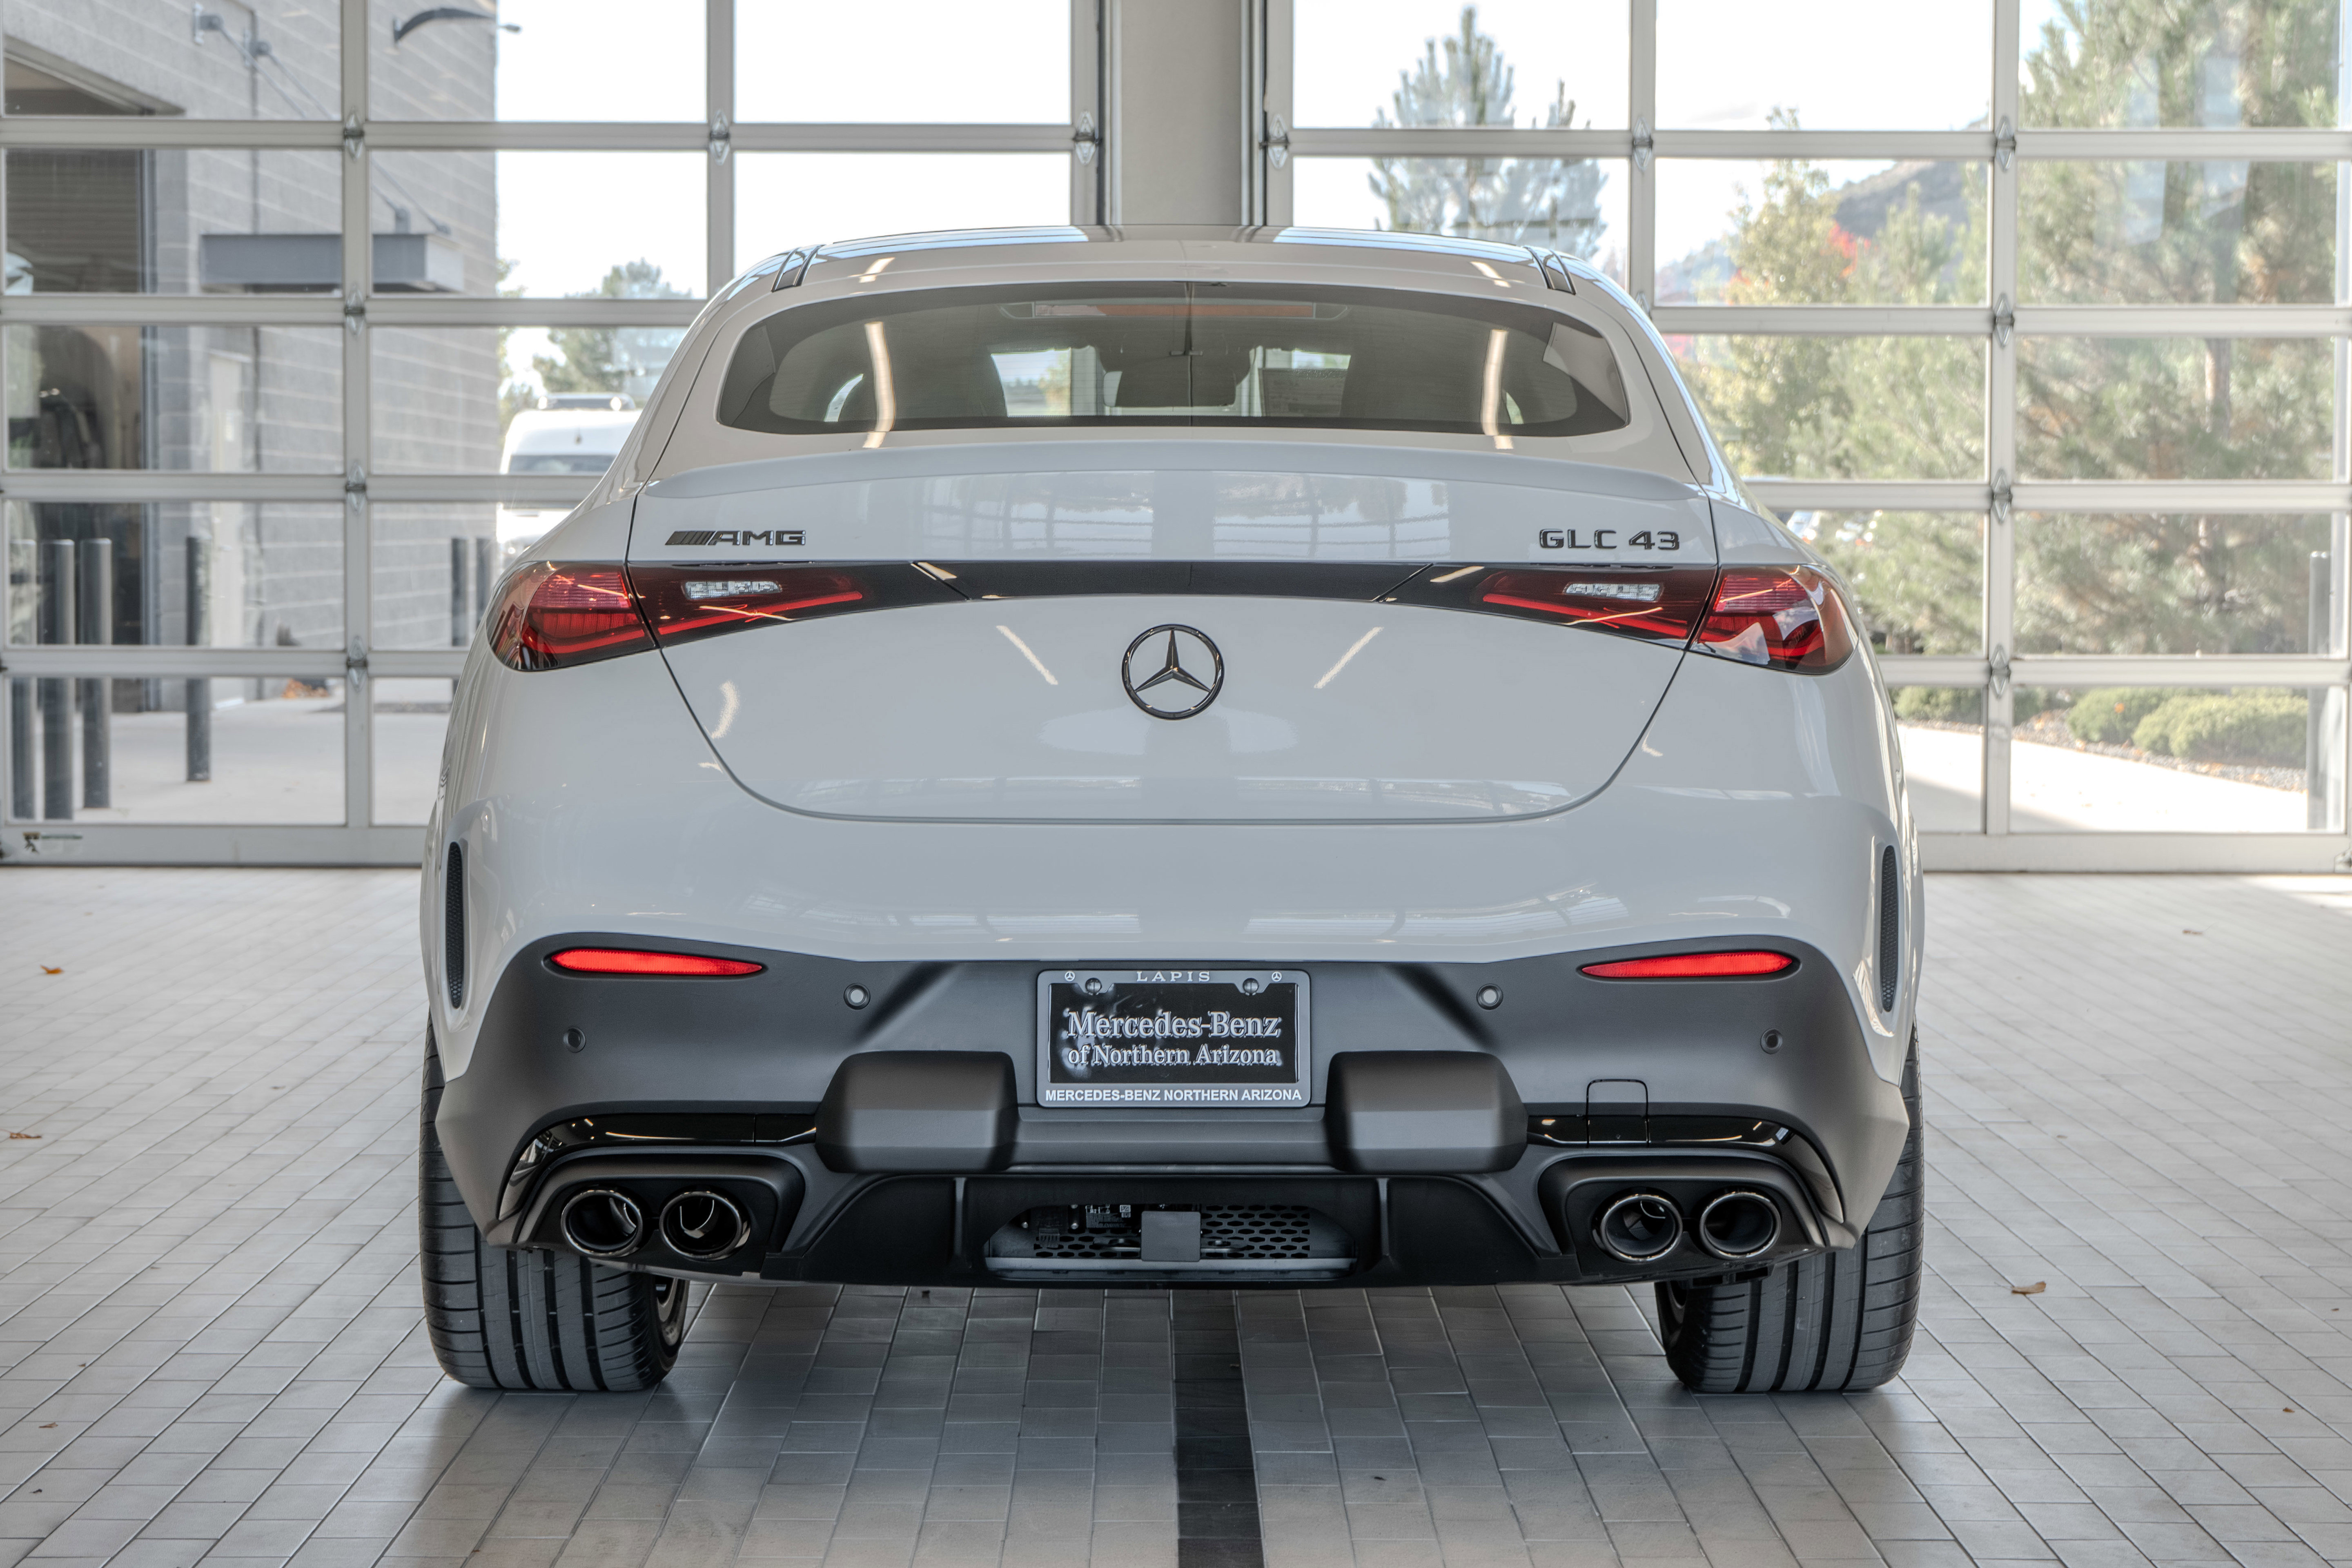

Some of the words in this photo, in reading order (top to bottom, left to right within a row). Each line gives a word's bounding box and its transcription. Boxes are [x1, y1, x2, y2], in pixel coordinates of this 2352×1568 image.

[707, 530, 806, 546] AMG
[1539, 528, 1617, 549] GLC
[1628, 530, 1680, 550] 43
[1136, 971, 1210, 982] LAPIS
[1067, 1011, 1279, 1037] Mercedes-Benz
[1067, 1045, 1091, 1064] of
[1094, 1044, 1189, 1065] Northern
[1195, 1044, 1278, 1065] Arizona
[1045, 1089, 1161, 1101] MERCEDES-BENZ
[1164, 1089, 1238, 1101] NORTHERN
[1241, 1089, 1302, 1101] ARIZONA
